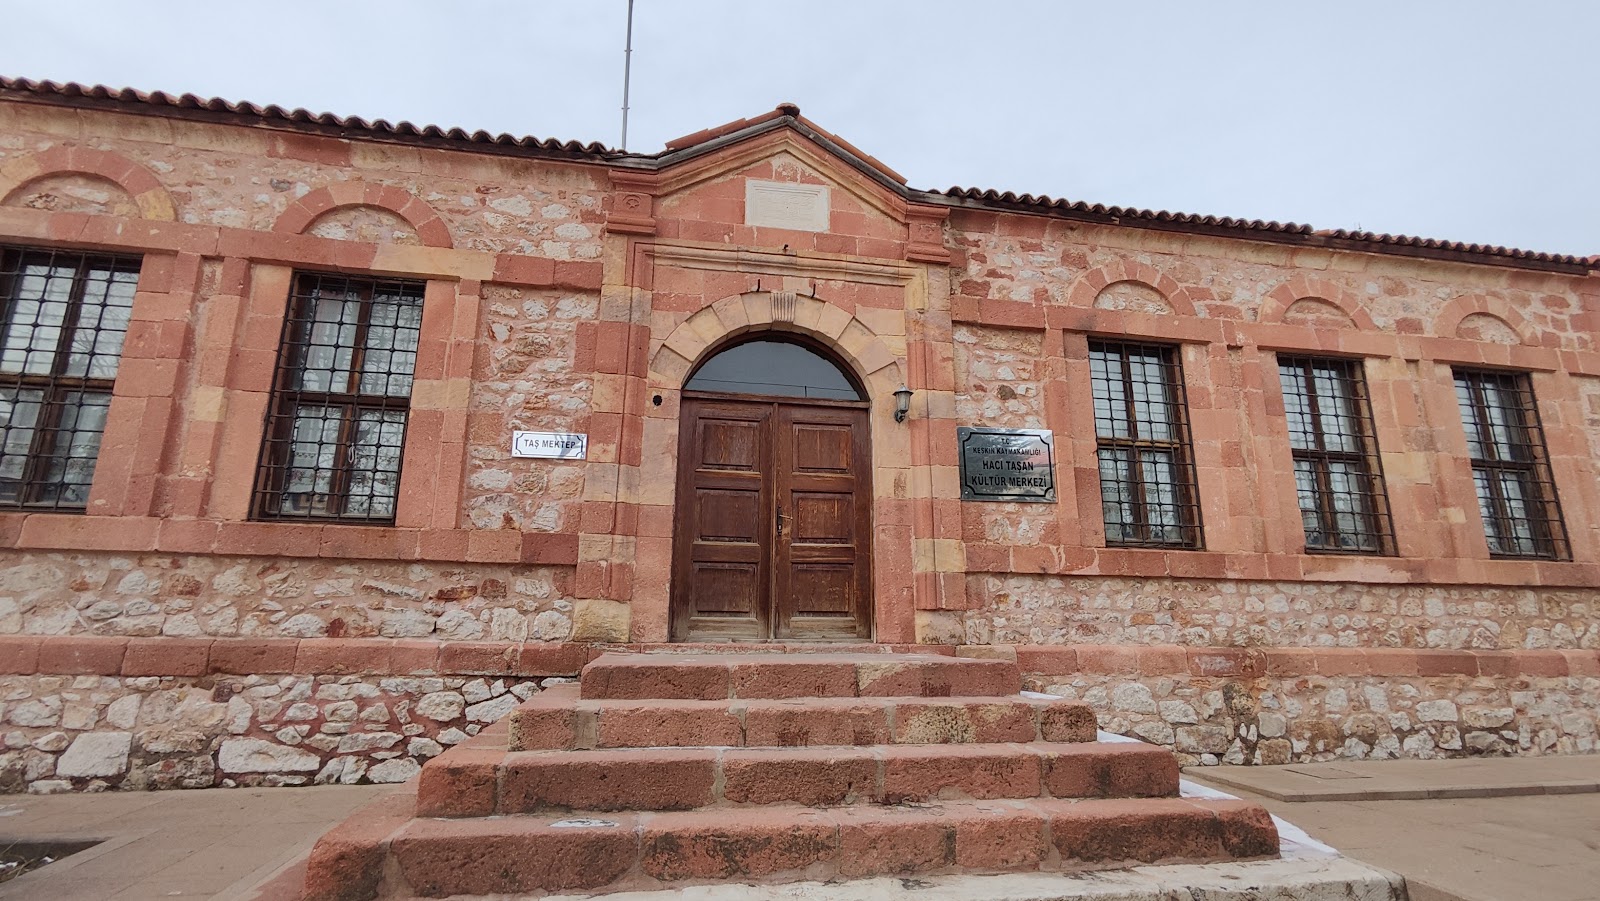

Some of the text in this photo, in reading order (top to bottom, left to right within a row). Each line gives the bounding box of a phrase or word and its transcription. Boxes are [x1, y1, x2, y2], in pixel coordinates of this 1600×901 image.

[524, 439, 576, 449] TAŞ MEKTEP
[982, 460, 1034, 474] HACI TAŞAN
[971, 474, 1047, 487] KÜLTÜR MERKEZİ
